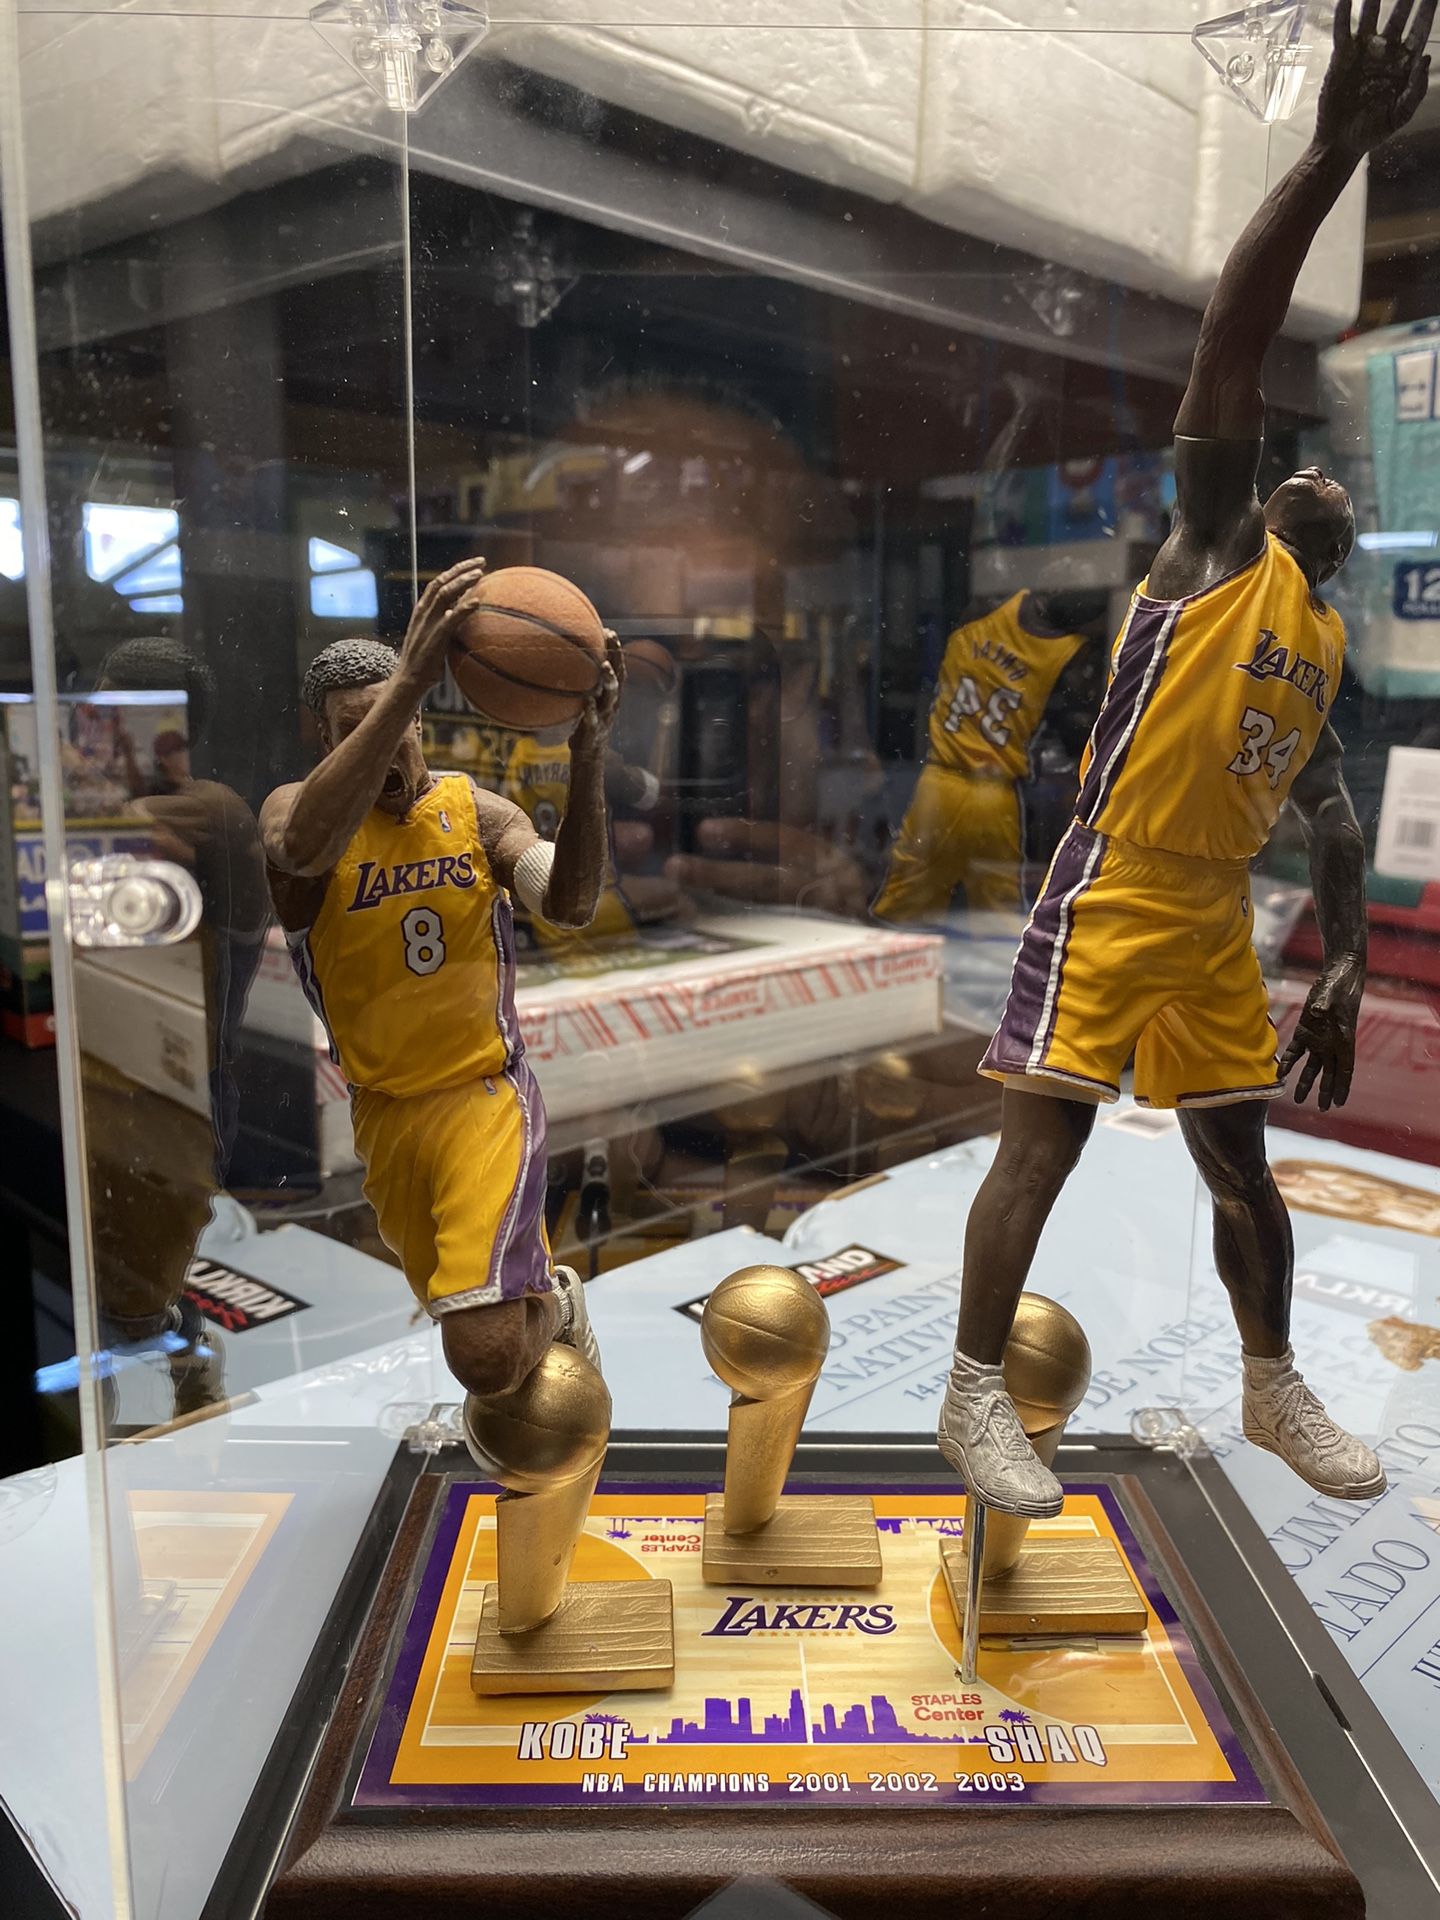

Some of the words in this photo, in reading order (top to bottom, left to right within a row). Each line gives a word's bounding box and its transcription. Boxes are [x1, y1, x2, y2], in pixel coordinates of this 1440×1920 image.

[1233, 628, 1329, 713] LAKER
[1225, 706, 1301, 791] 34
[346, 852, 477, 912] LAKERS
[401, 906, 446, 977] 8
[701, 1596, 898, 1637] LAKERS
[911, 1693, 983, 1706] STAPLES
[914, 1707, 985, 1721] Center
[517, 1722, 630, 1760] KOBE
[984, 1725, 1108, 1767] SHAQ
[582, 1773, 624, 1793] NBA
[643, 1773, 770, 1793] CHAMPIONS
[787, 1772, 851, 1793] 2001
[868, 1772, 939, 1793] 2002
[954, 1772, 1026, 1793] 2003
